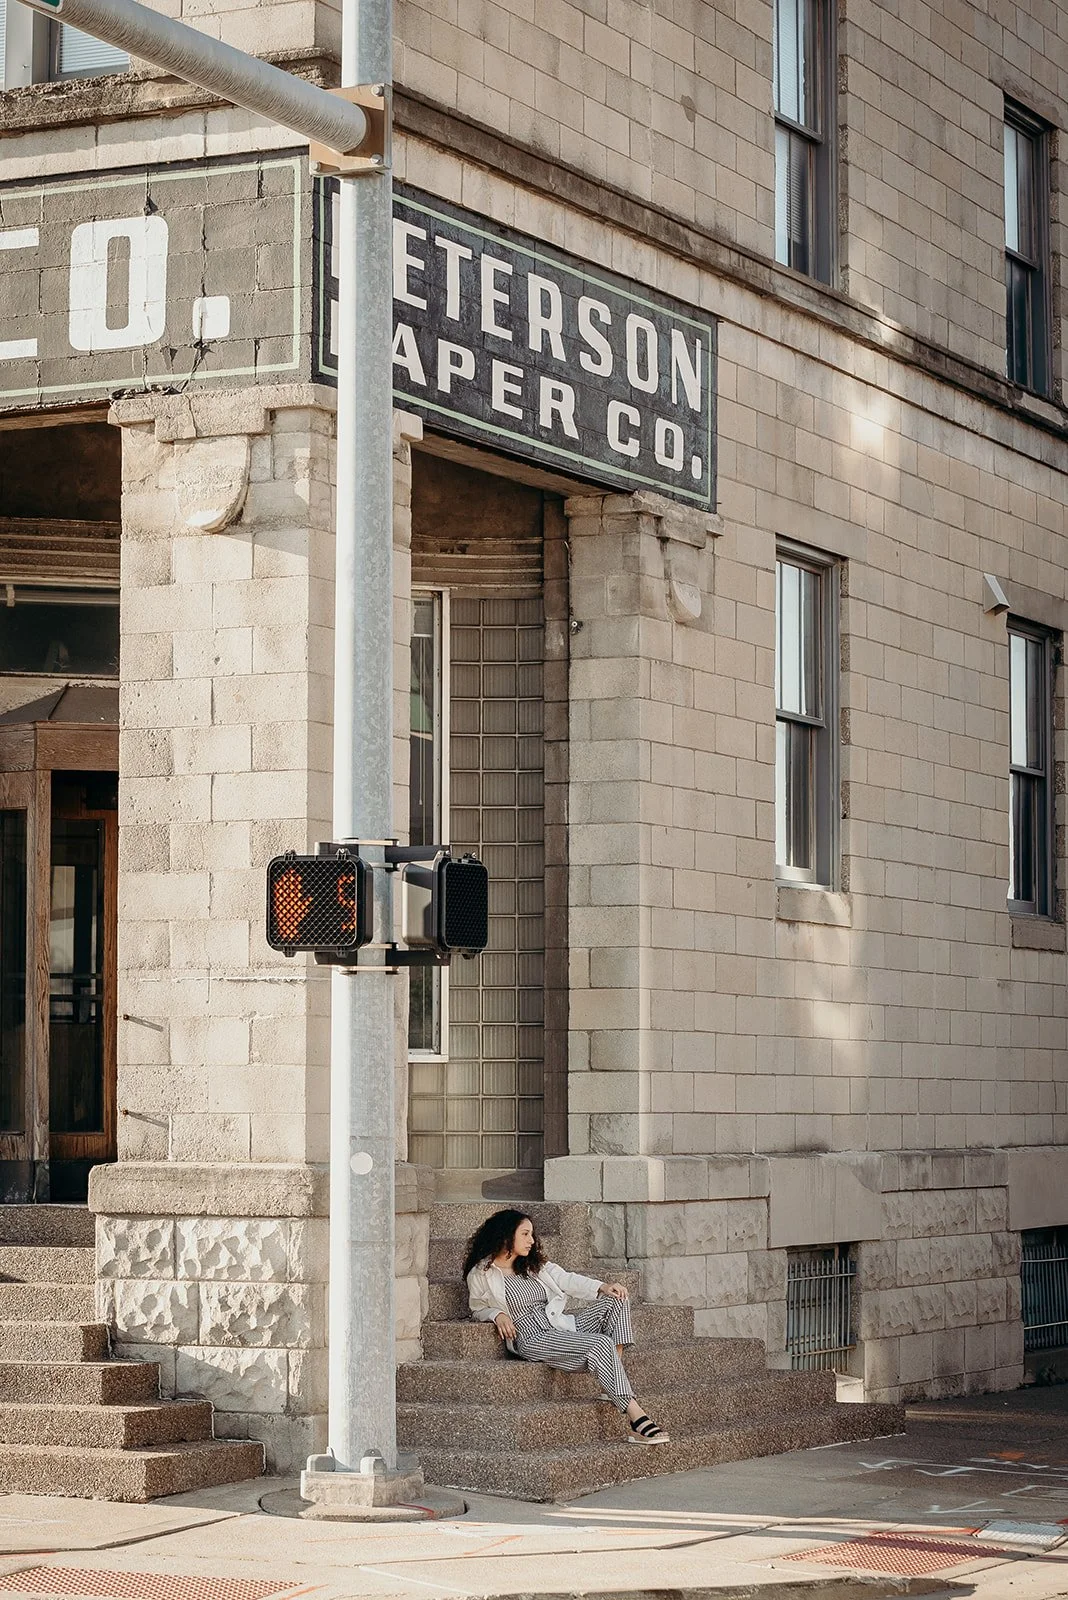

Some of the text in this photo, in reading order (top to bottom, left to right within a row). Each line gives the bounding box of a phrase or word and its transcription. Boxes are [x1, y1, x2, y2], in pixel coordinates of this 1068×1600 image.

[330, 299, 702, 480] APER CO.
[331, 192, 702, 412] ETERSON
